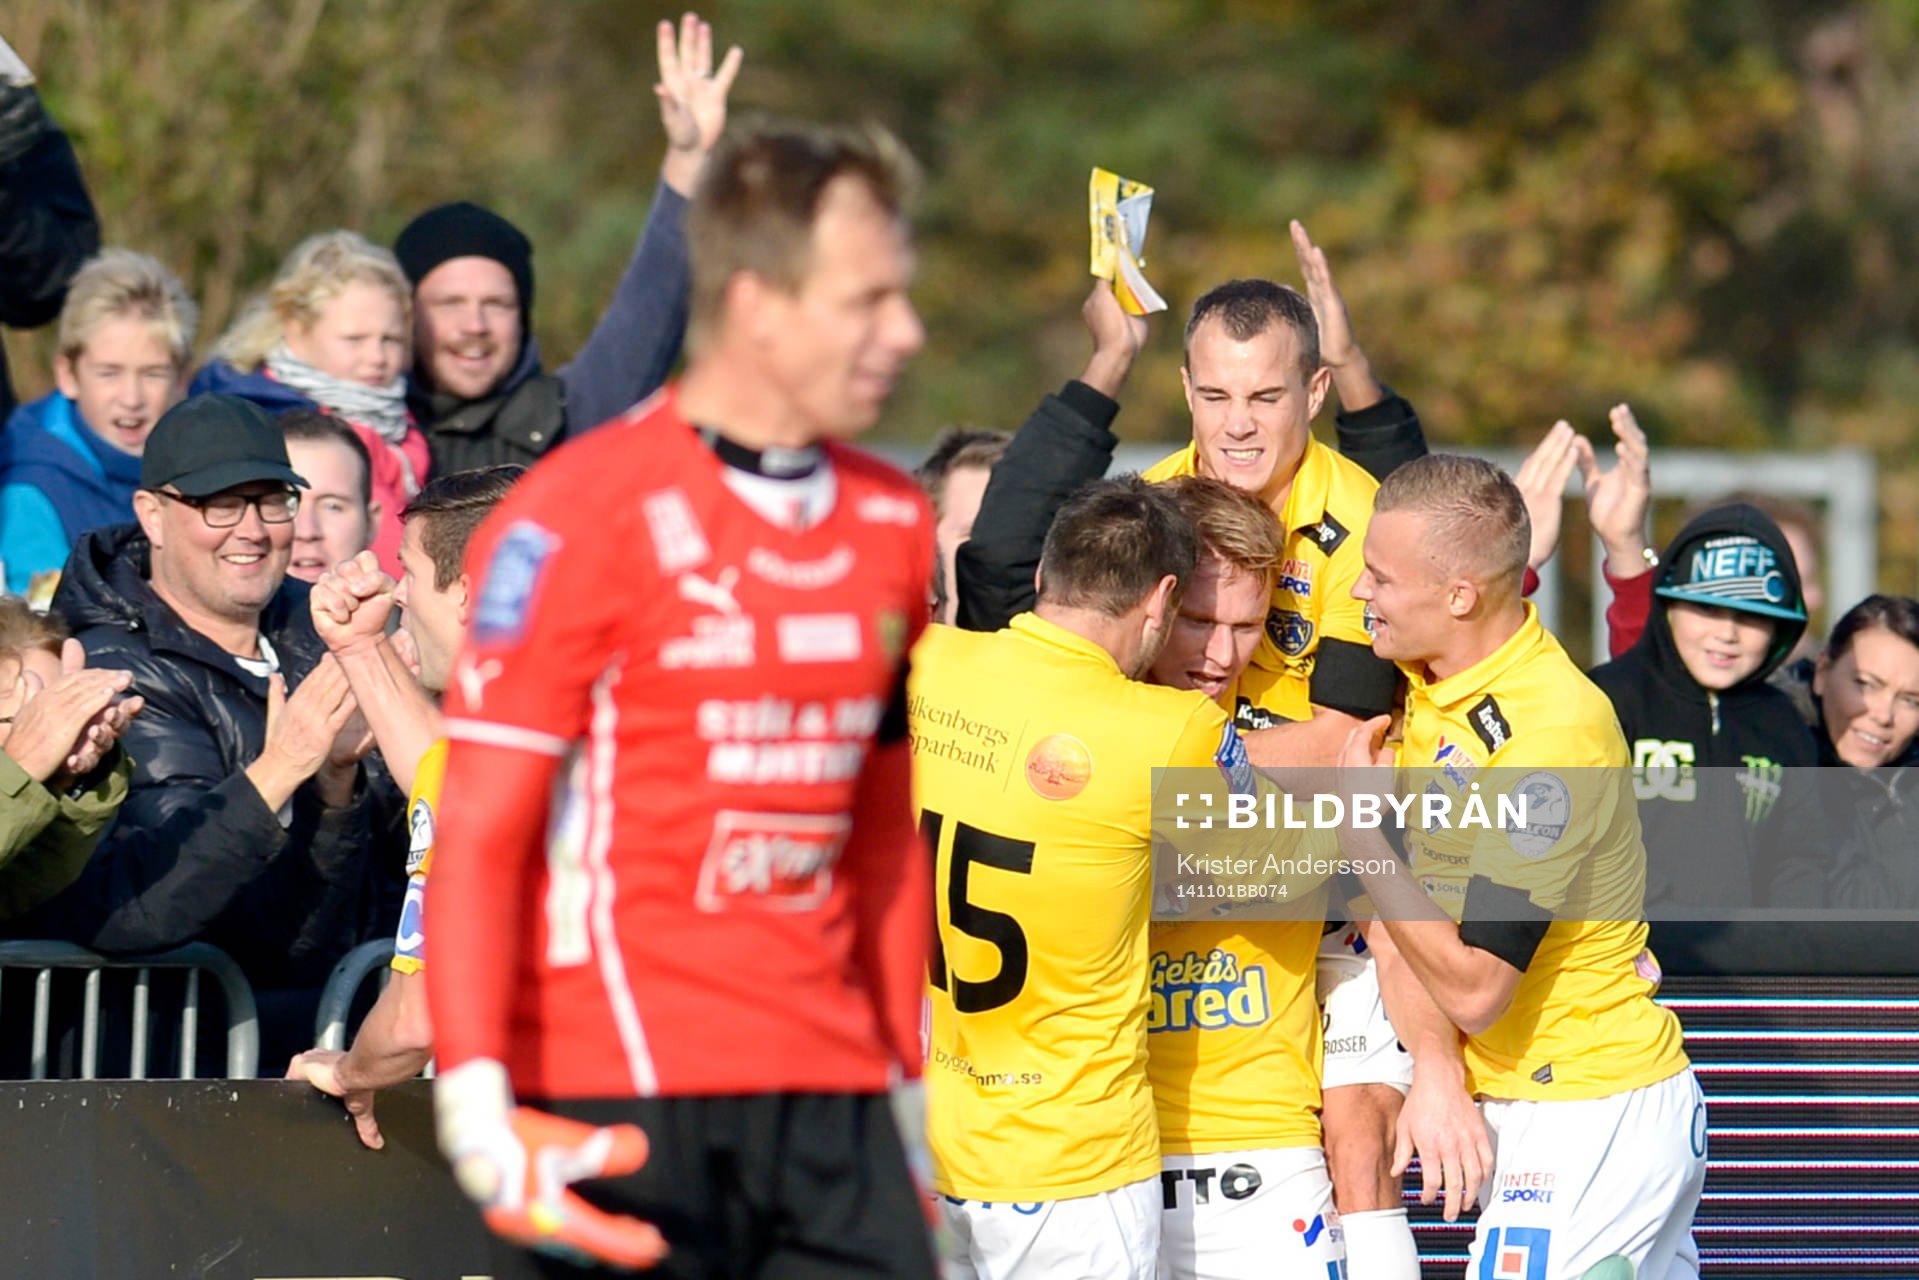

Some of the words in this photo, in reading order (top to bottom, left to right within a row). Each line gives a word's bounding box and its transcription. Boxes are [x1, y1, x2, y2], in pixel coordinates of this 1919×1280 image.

[1689, 546, 1775, 584] NEFF
[907, 694, 1009, 748] alkenbergs
[1150, 949, 1238, 990] Gekås
[1147, 970, 1267, 1029] ared
[1323, 1034, 1367, 1055] ROSSER
[1160, 1162, 1263, 1211] TTO
[1502, 1189, 1555, 1203] SPORT
[1503, 1172, 1556, 1187] INTER
